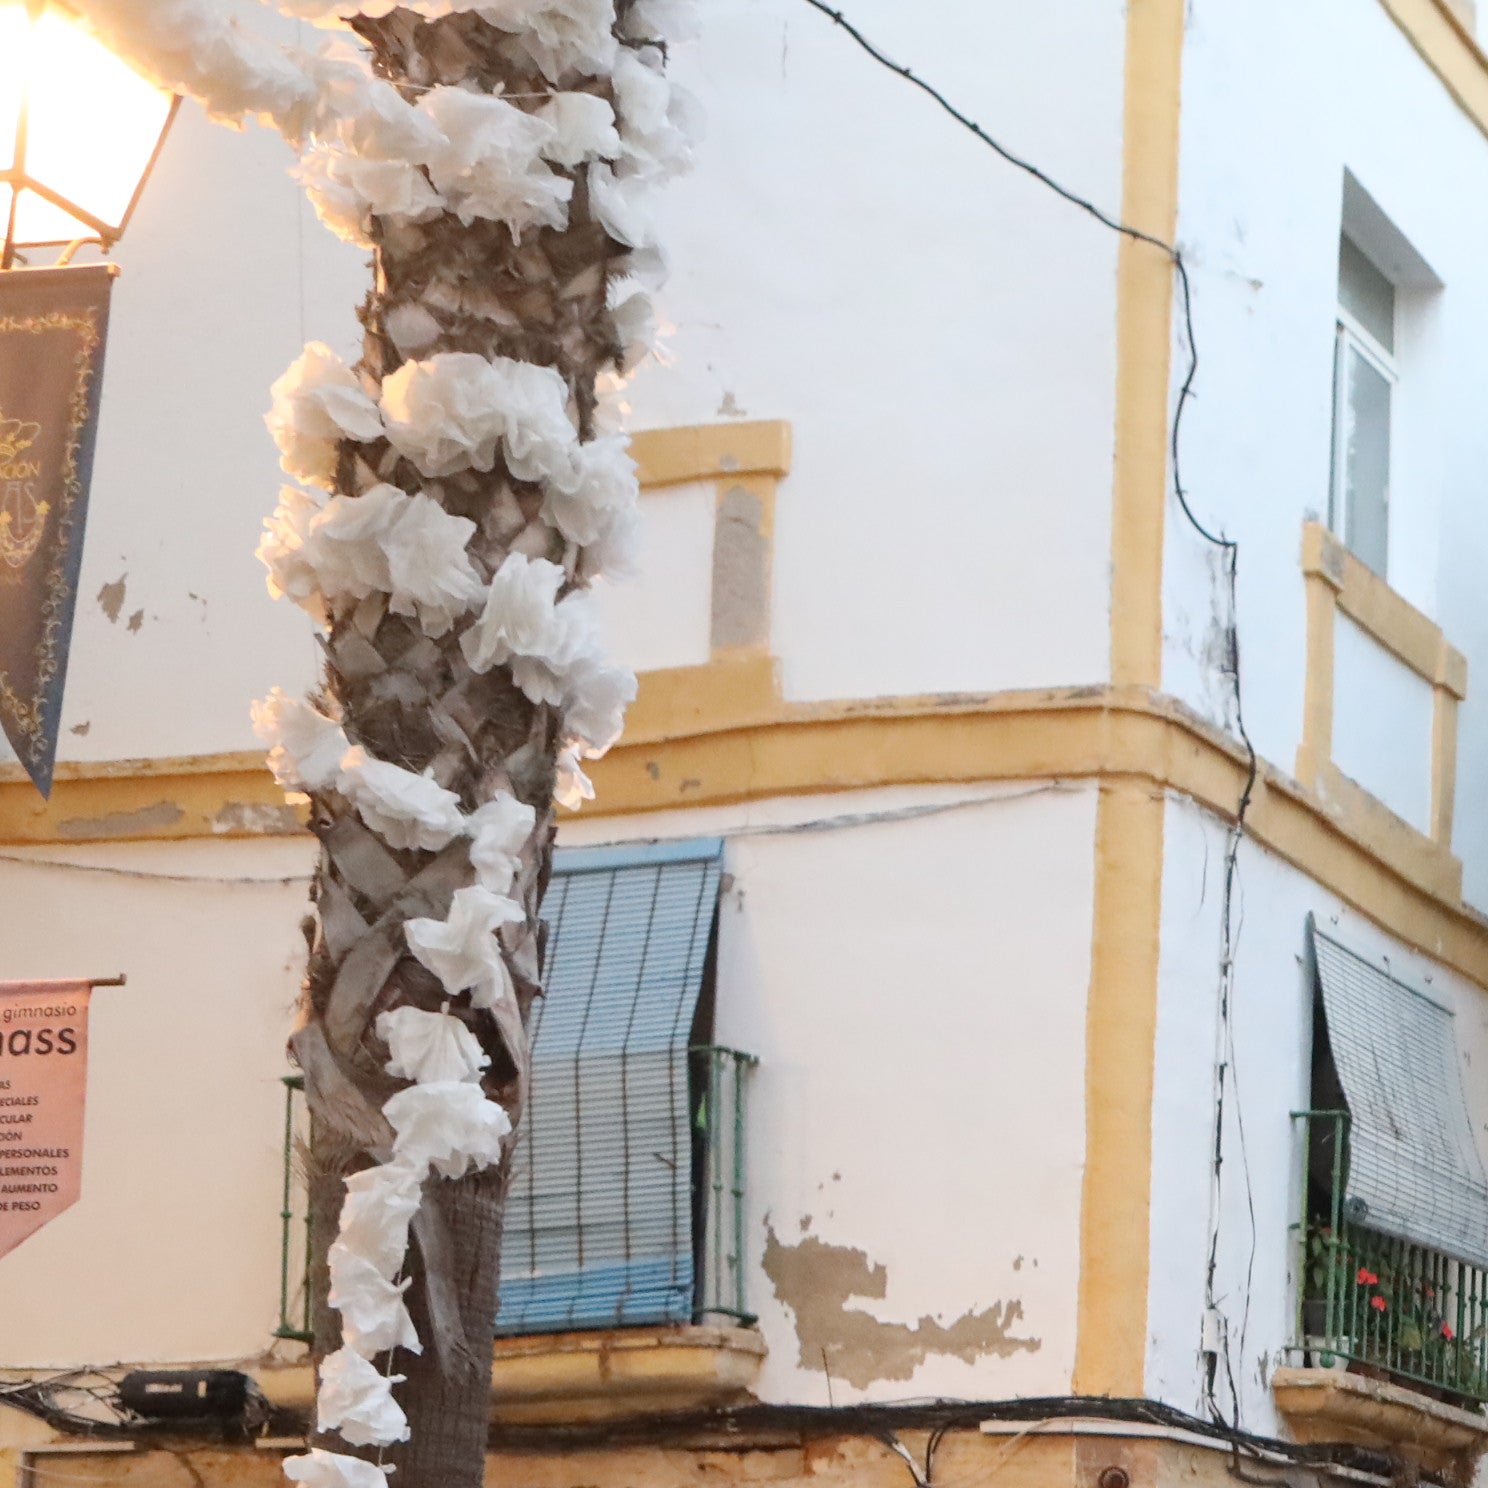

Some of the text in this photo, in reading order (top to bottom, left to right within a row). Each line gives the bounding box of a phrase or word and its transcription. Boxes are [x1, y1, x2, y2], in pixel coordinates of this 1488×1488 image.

[3, 1001, 77, 1023] gimnasio
[0, 1027, 77, 1056] ass
[0, 1148, 69, 1159] PERSONALES
[1, 1183, 58, 1194] AUMENTO
[11, 1201, 41, 1212] PESO
